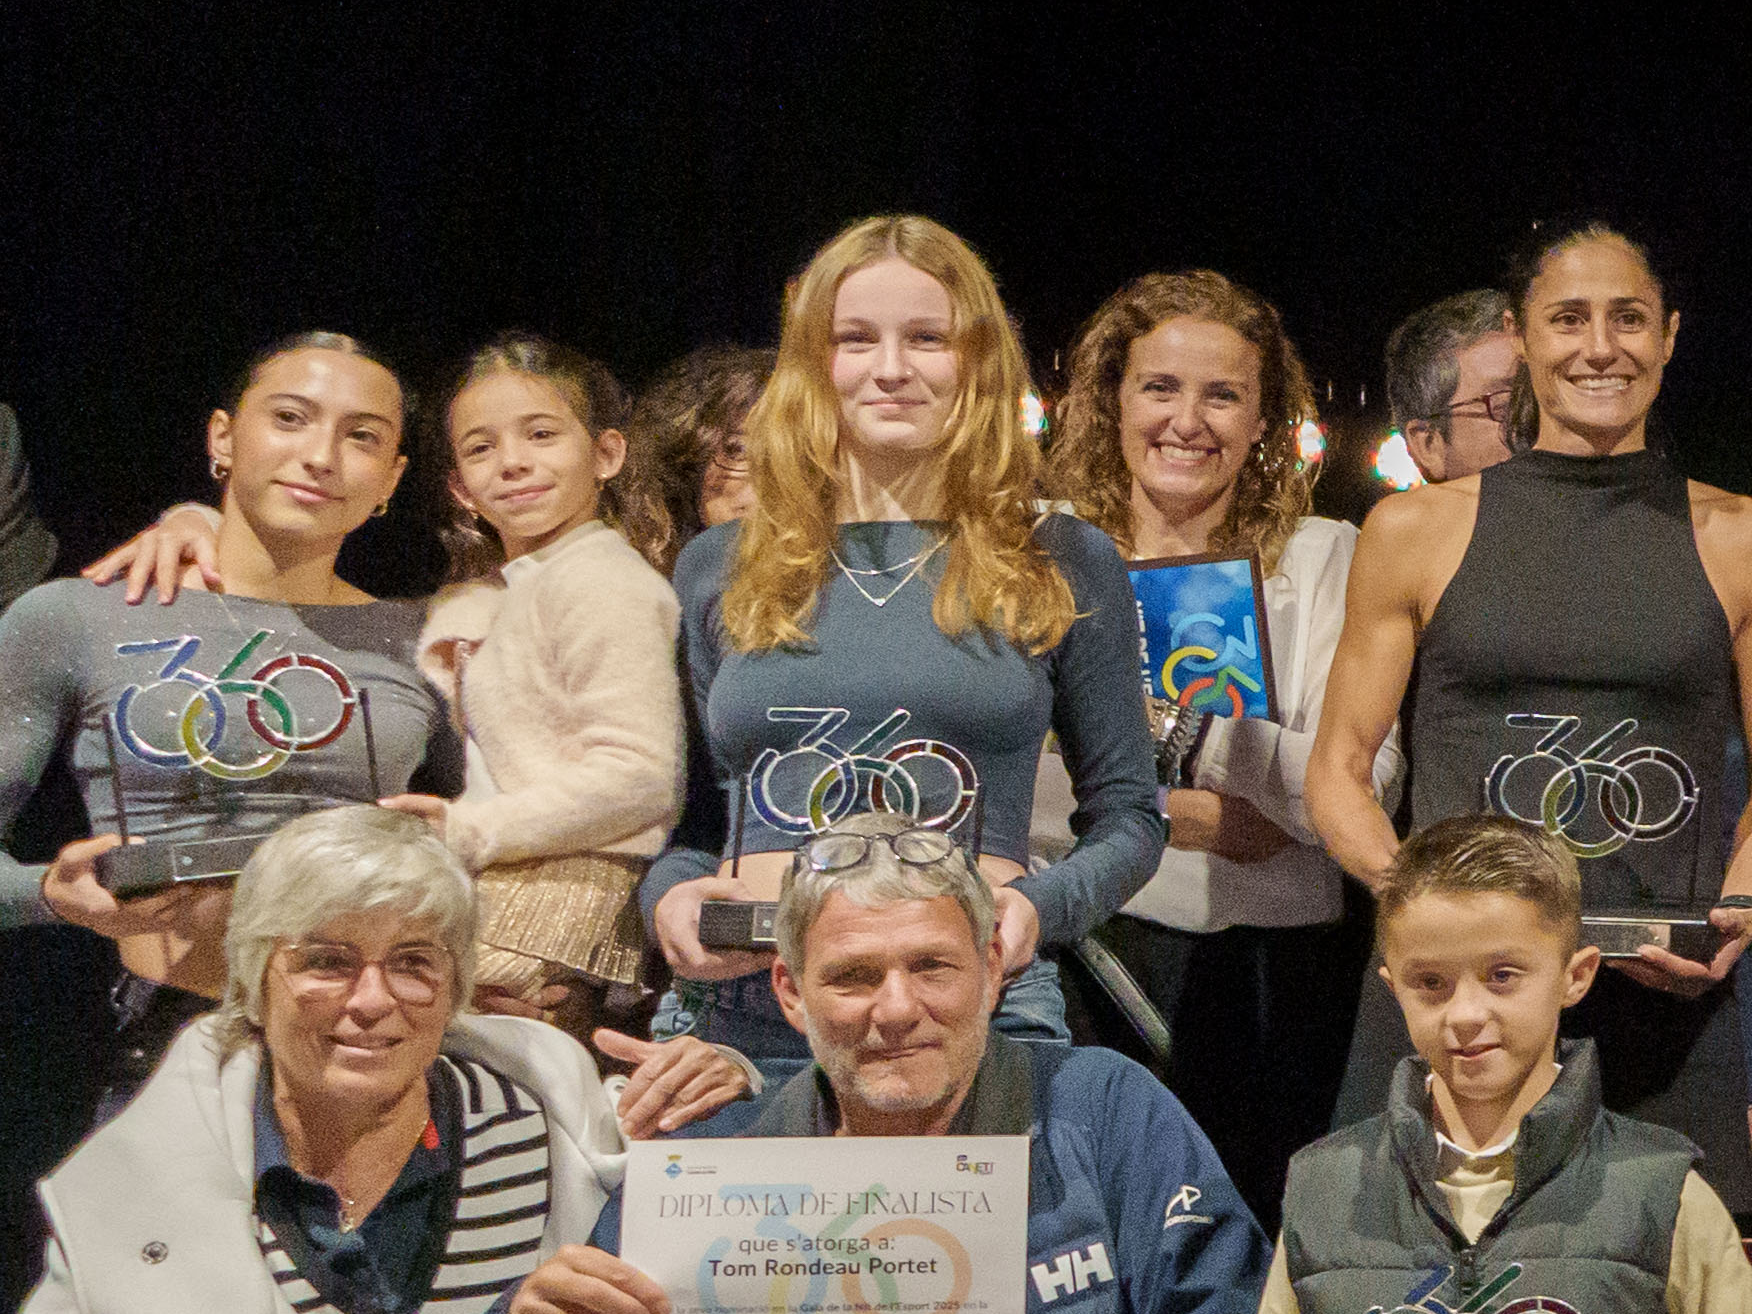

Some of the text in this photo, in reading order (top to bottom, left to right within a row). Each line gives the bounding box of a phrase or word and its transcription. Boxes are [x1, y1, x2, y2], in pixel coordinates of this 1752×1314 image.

[659, 1190, 993, 1218] DIPLOMA DE FINALISTA
[738, 1234, 895, 1256] que s'atorga a:
[708, 1257, 938, 1277] Tom Rondeau Portet
[1030, 1242, 1114, 1304] HH
